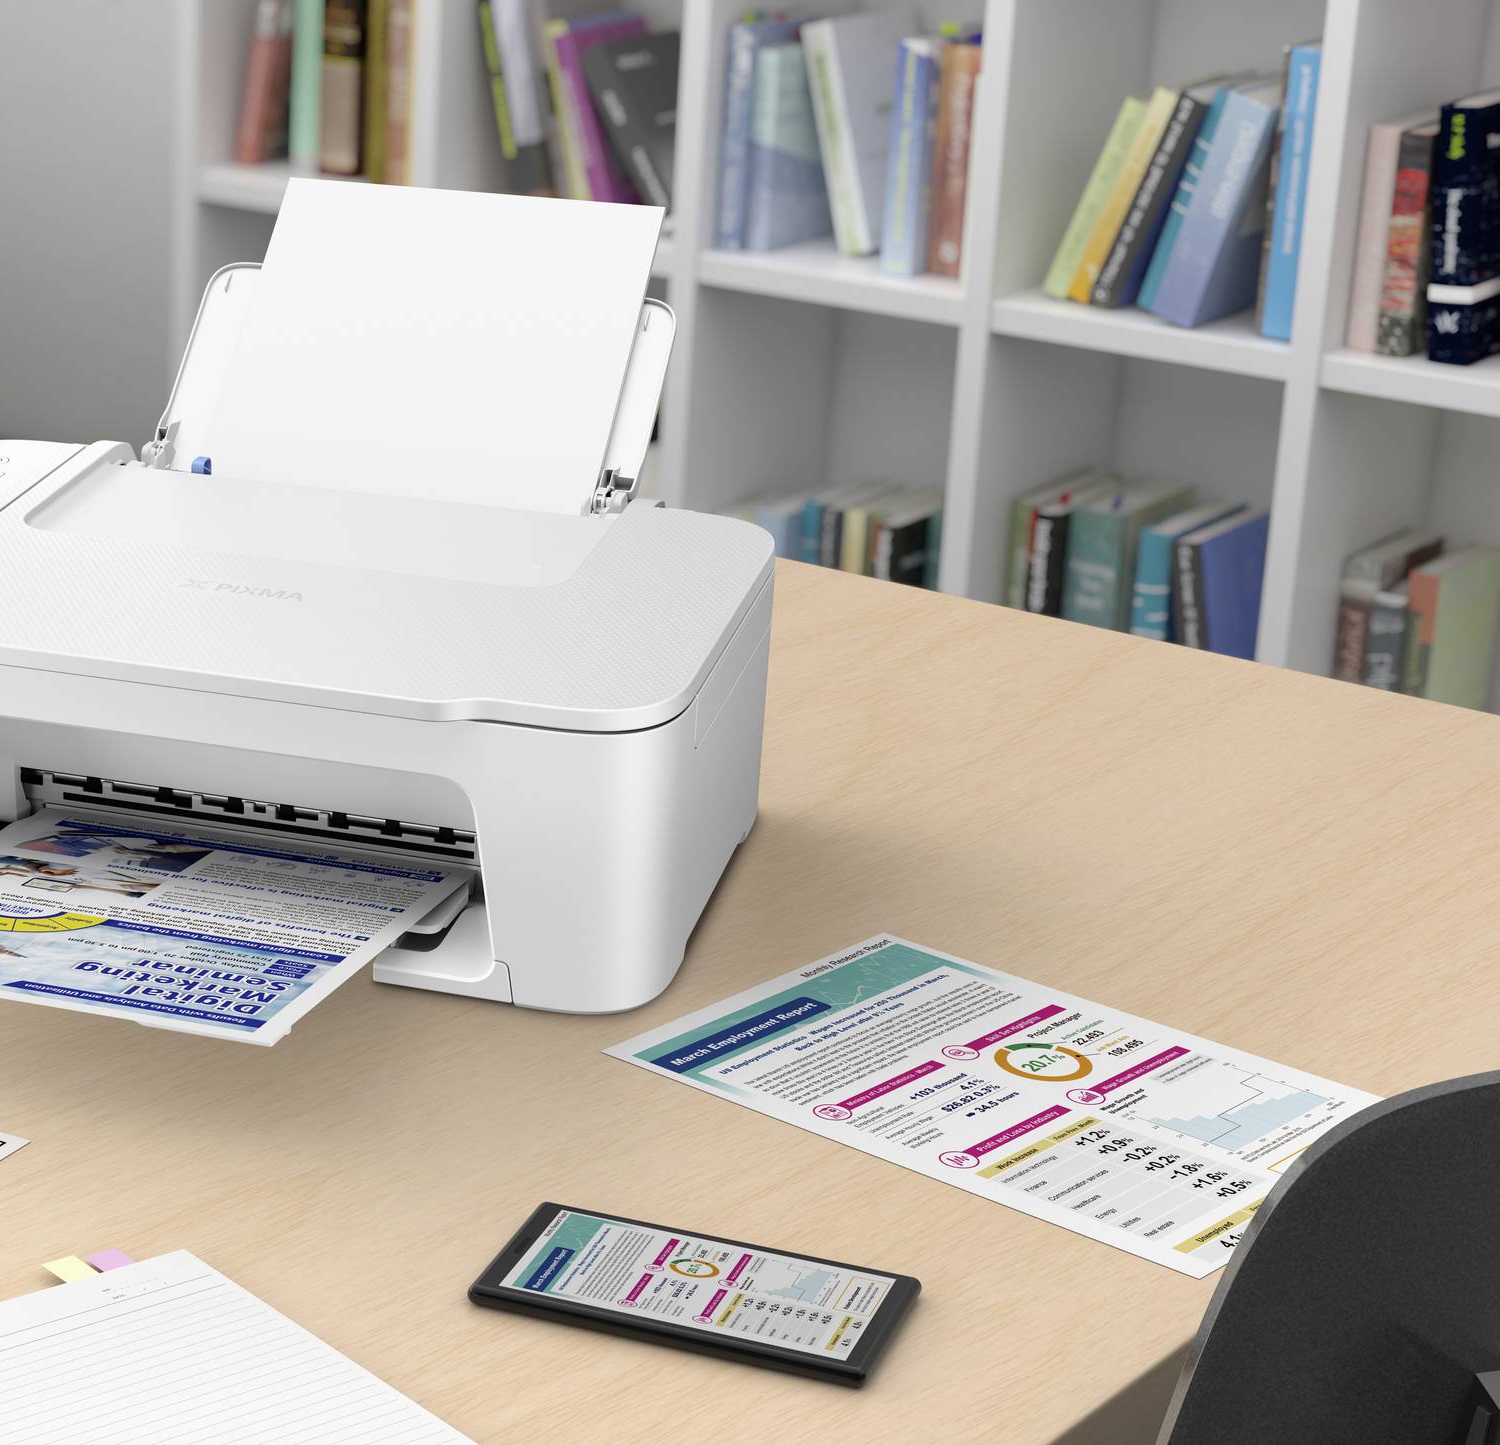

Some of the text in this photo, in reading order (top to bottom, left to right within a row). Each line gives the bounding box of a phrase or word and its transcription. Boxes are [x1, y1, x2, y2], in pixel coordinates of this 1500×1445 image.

[214, 583, 303, 602] PIXMA
[117, 922, 150, 931] basics
[172, 931, 199, 939] from
[201, 935, 258, 948] marketing
[258, 945, 295, 954] digital
[297, 951, 329, 959] Learn
[800, 939, 892, 978] Monthly Research Report
[76, 961, 275, 1003] Marketing
[132, 959, 290, 991] Seminar
[104, 996, 149, 1007] Analysis
[124, 985, 261, 1015] Digital
[150, 1004, 177, 1012] Data
[206, 1013, 246, 1024] Results
[1026, 1012, 1082, 1039] Project Manager
[670, 1002, 817, 1066] March Employment Report
[1072, 1030, 1105, 1046] 22,493
[1021, 1054, 1066, 1073] 20.7%
[933, 1072, 968, 1090] thousand
[941, 1095, 977, 1112] $26.82
[974, 1100, 999, 1113] 34.5
[1075, 1129, 1111, 1146] +1.2%
[1098, 1137, 1134, 1154] +0.9%
[1145, 1154, 1180, 1171] +0.2%
[1192, 1171, 1228, 1189] +1.6%
[1216, 1180, 1252, 1198] +0.5%
